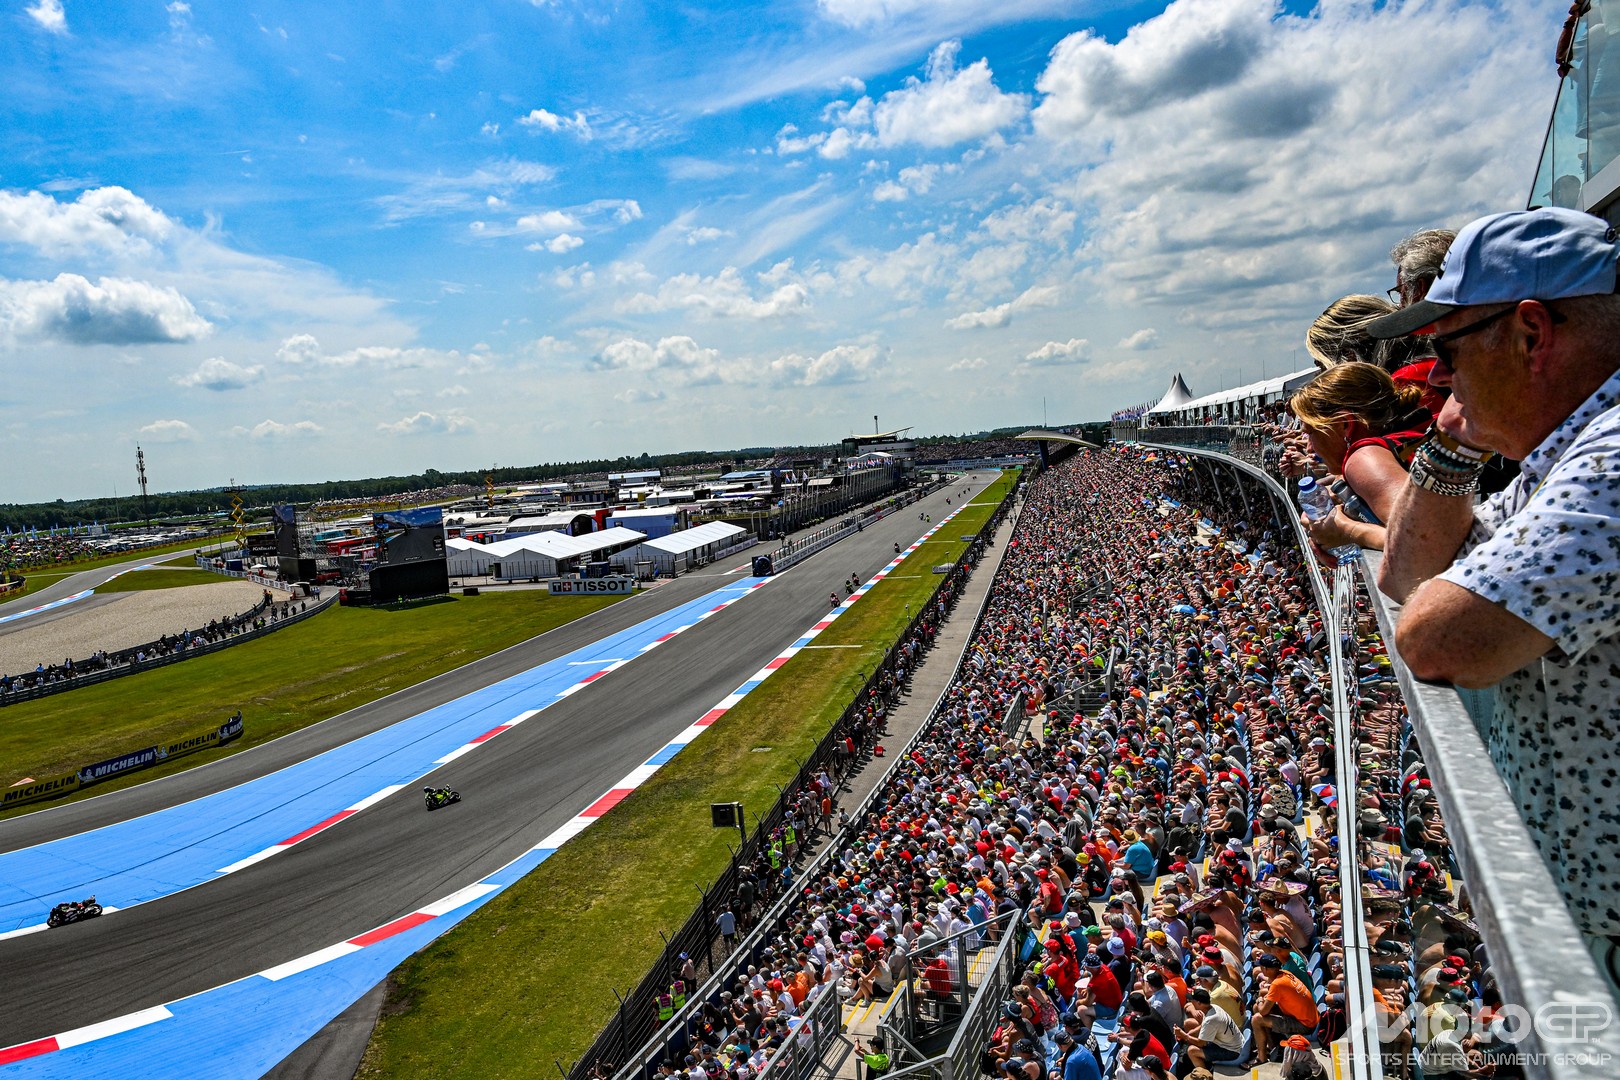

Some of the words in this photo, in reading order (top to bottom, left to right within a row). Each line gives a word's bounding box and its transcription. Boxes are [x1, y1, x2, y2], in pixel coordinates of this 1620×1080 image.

[574, 581, 627, 592] TISSOT
[169, 732, 217, 753] MICHELIN
[95, 752, 153, 777] MICHELIN
[3, 775, 76, 802] MICHELIN
